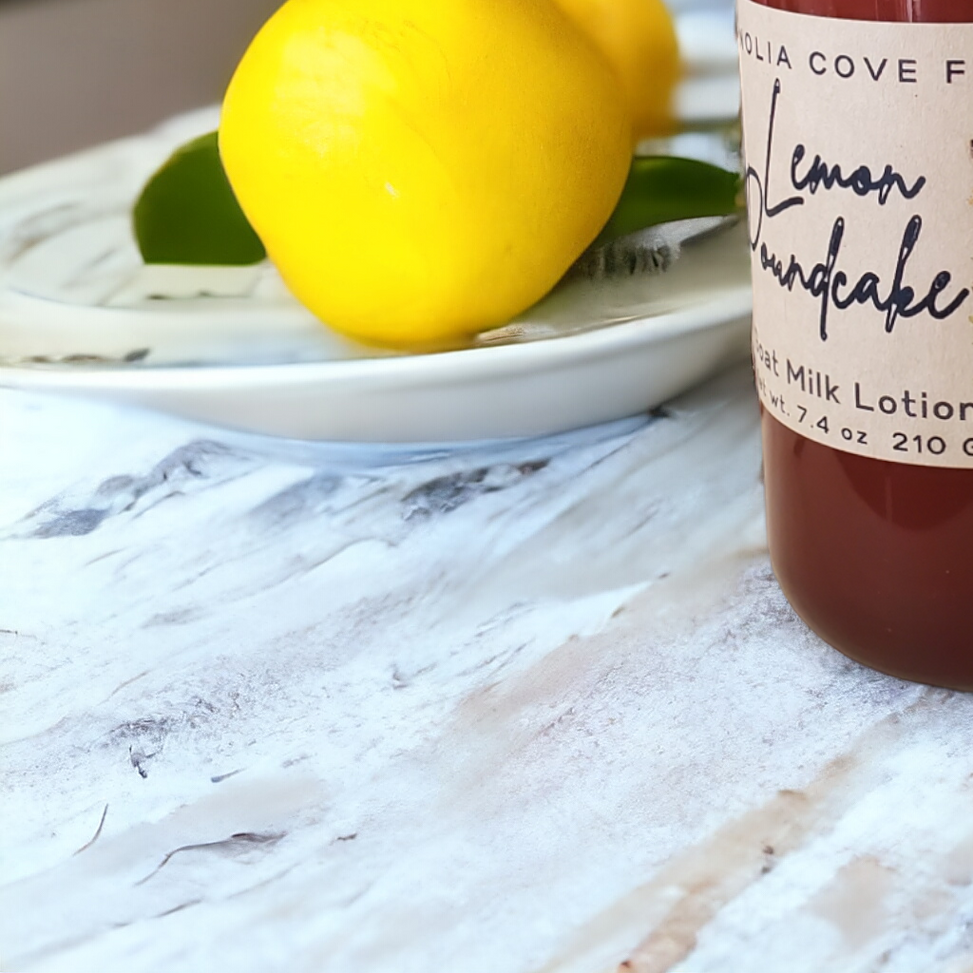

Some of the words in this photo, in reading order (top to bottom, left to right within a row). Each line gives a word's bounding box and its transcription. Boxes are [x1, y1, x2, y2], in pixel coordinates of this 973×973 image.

[809, 51, 917, 83] COVE
[764, 78, 926, 217] Lemon
[786, 358, 841, 404] Milk
[797, 404, 829, 434] 7.4
[841, 428, 868, 444] oz
[892, 432, 946, 455] 210
